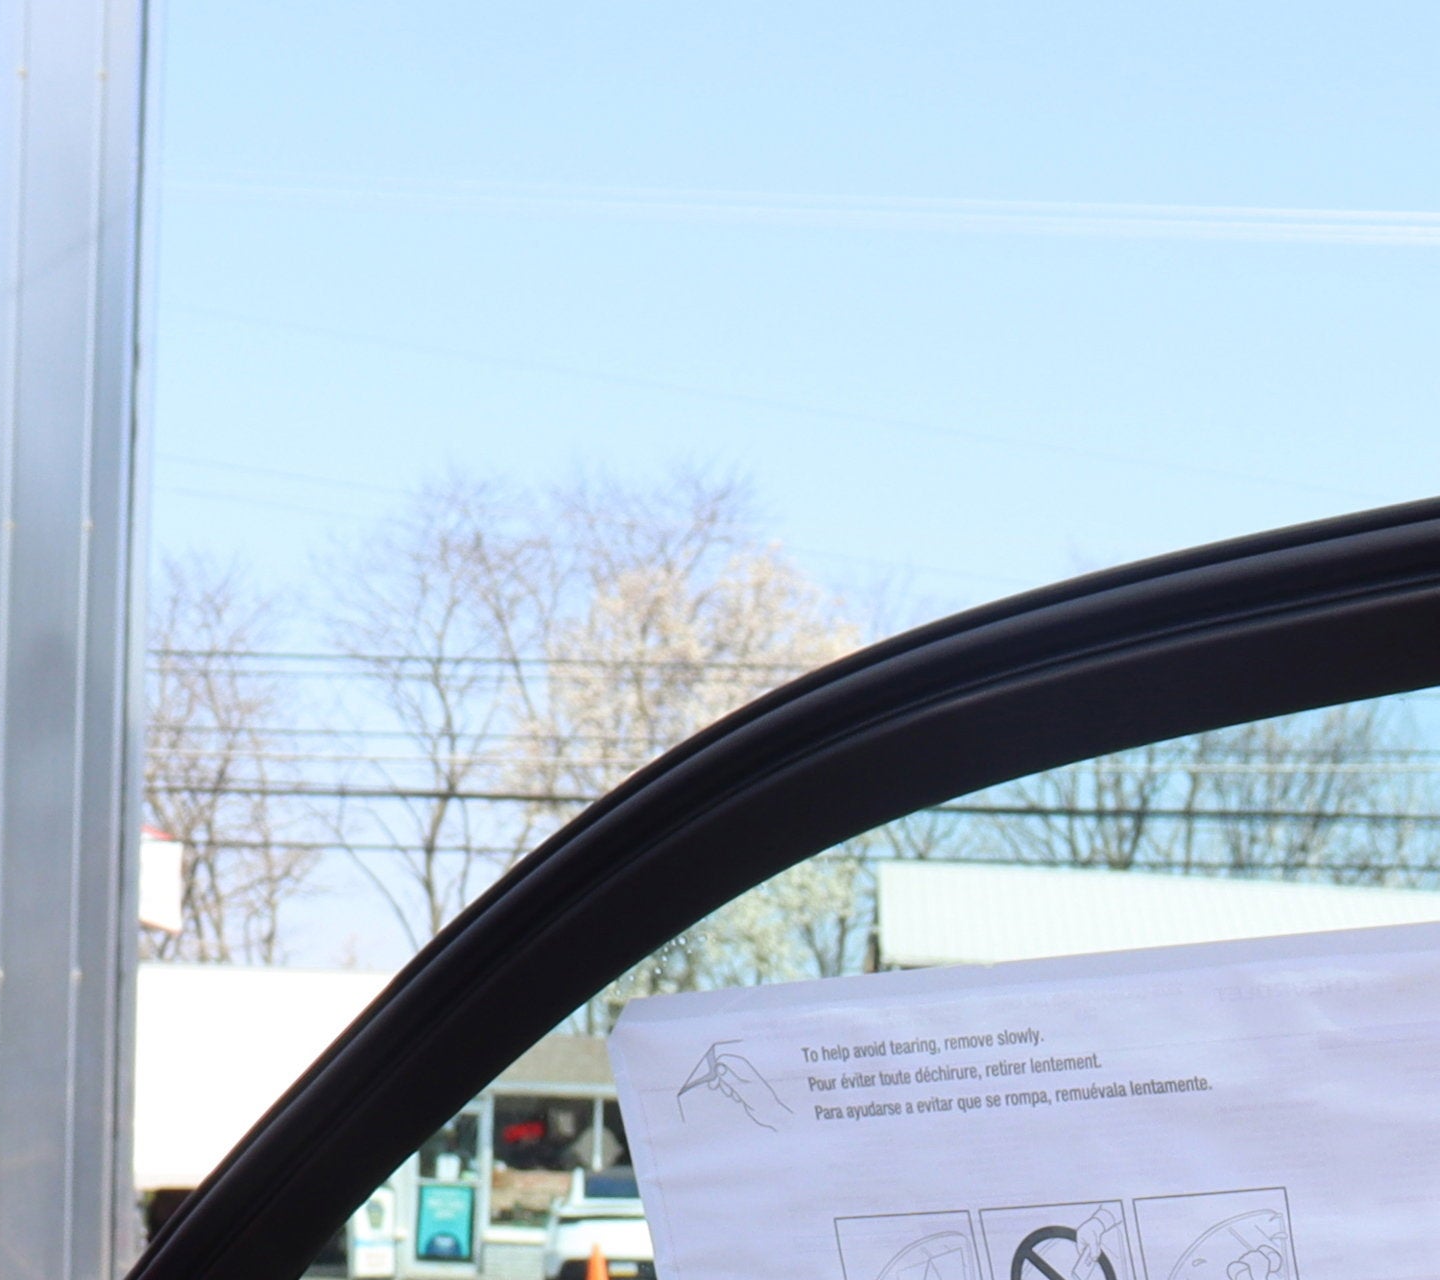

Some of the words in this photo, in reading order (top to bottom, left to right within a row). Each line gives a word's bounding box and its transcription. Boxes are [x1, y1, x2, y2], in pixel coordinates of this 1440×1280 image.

[801, 1047, 819, 1063] To
[821, 1043, 850, 1063] help
[853, 1041, 887, 1059] avoid
[889, 1037, 941, 1056] tearing,
[944, 1032, 994, 1051] remove
[997, 1027, 1044, 1047] slowly.
[808, 1075, 837, 1093] Pour
[841, 1072, 876, 1090] éviter
[878, 1070, 911, 1087] toute
[914, 1064, 982, 1085] déchirure,
[985, 1059, 1026, 1078] retirer
[1030, 1053, 1102, 1074] lentement.
[814, 1104, 844, 1121] Para
[846, 1101, 903, 1121] ayudarse
[906, 1102, 914, 1114] a
[917, 1097, 953, 1114] evitar
[956, 1096, 982, 1113] que
[985, 1094, 1002, 1108] se
[1005, 1089, 1052, 1108] rompa,
[1055, 1082, 1127, 1103] remuévala
[1129, 1075, 1213, 1097] lentamente.
